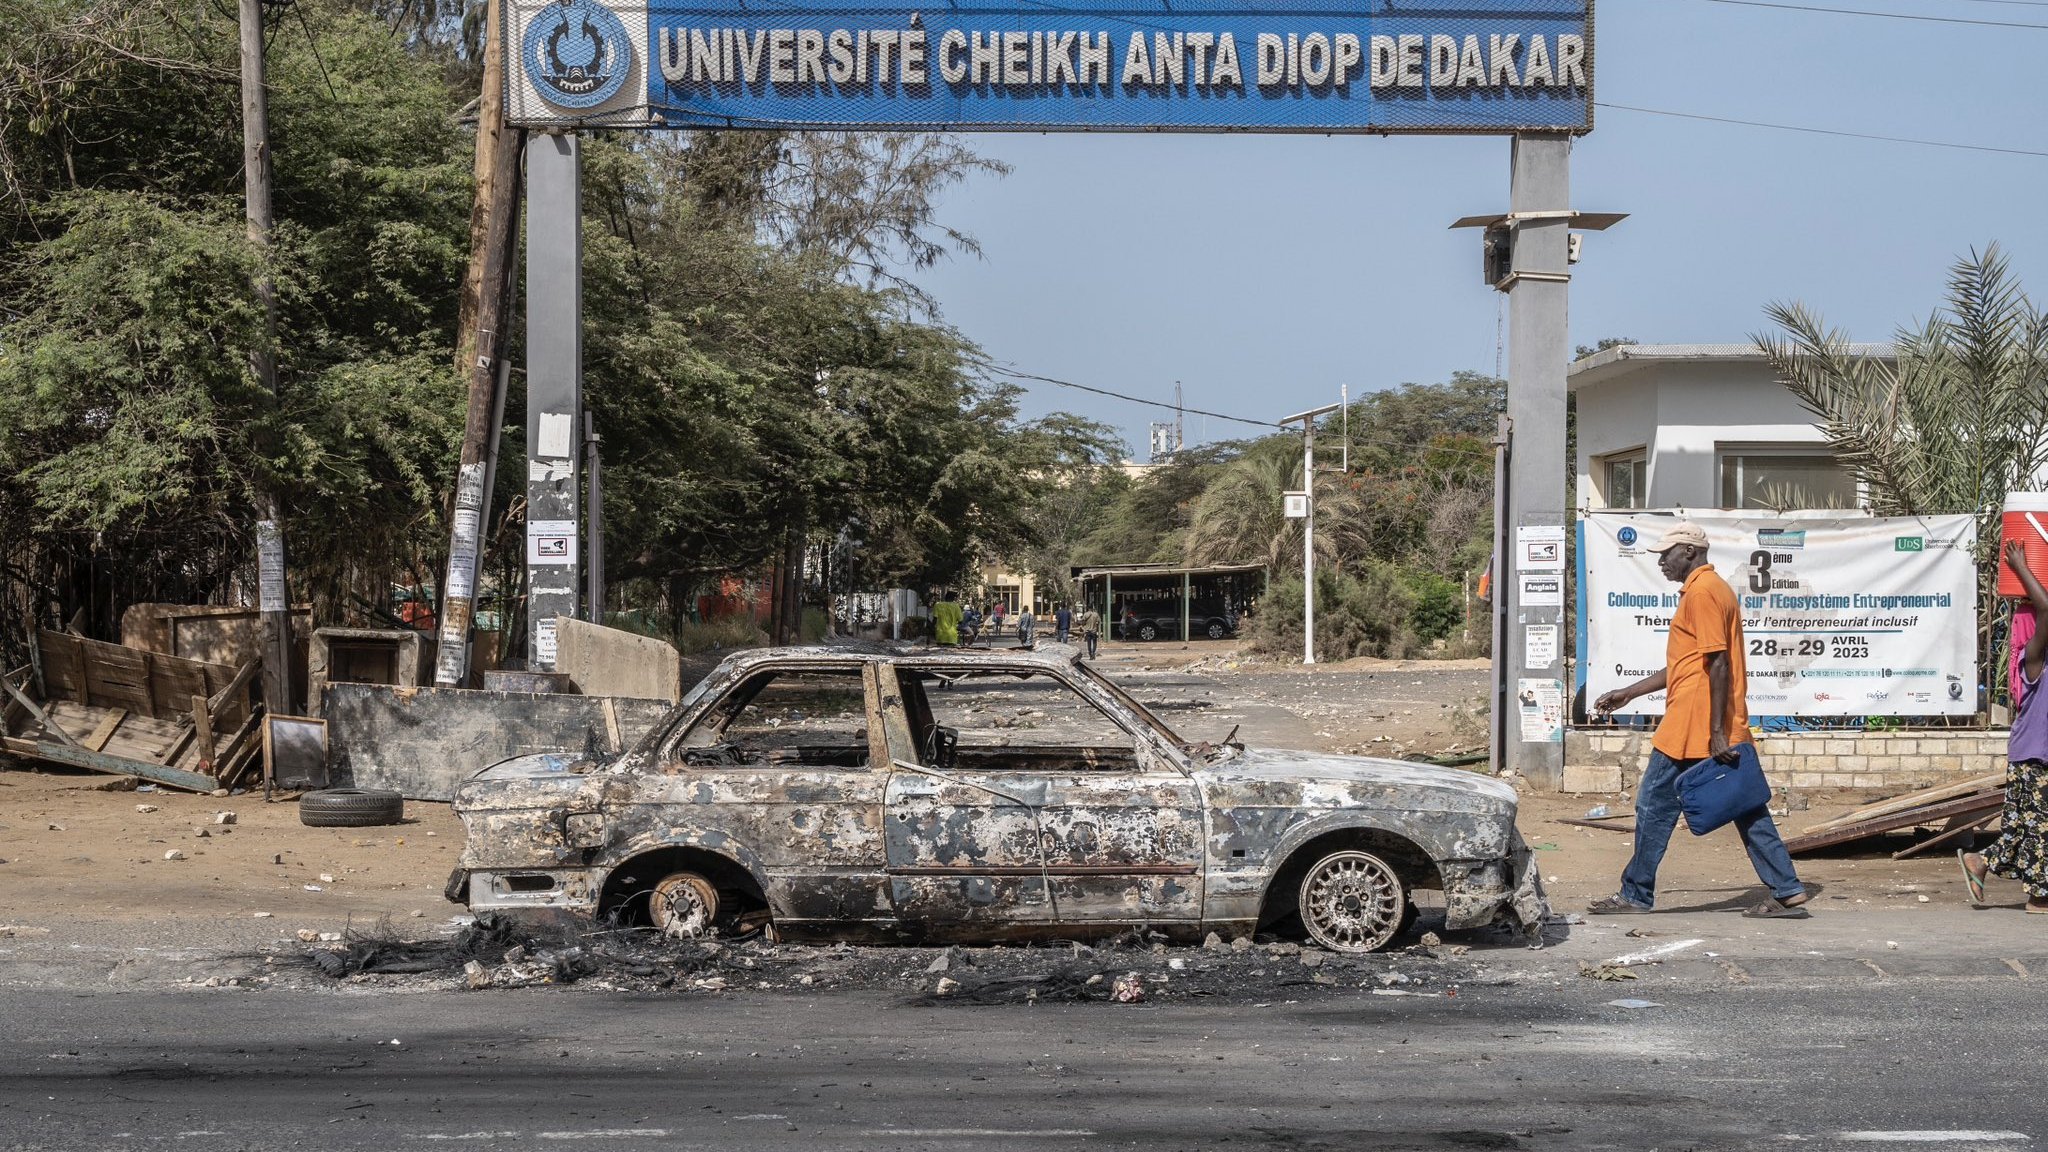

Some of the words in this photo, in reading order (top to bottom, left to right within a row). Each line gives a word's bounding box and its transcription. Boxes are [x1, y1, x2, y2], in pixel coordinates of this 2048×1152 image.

[658, 12, 925, 83] UNIVERSITÉ
[938, 28, 1109, 85] CHEIKH
[1120, 31, 1243, 85] ANTA
[1257, 32, 1361, 86] DIOP
[1370, 34, 1425, 87] DE
[1430, 33, 1587, 87] DAKAR
[1749, 549, 1772, 594] 3
[1526, 583, 1557, 592] Anglais
[1771, 578, 1800, 589] Edition
[1607, 591, 1659, 610] Colloque
[1744, 595, 1766, 609] sur
[1853, 592, 1952, 610] Entrepreneurial
[1764, 616, 1870, 629] l'entrepreneuriat
[1871, 615, 1919, 627] inclusif
[1749, 639, 1778, 656] 28
[1781, 648, 1795, 657] ET
[1798, 639, 1826, 657] 29
[1831, 636, 1869, 645] AVRIL
[1832, 647, 1869, 659] 2023
